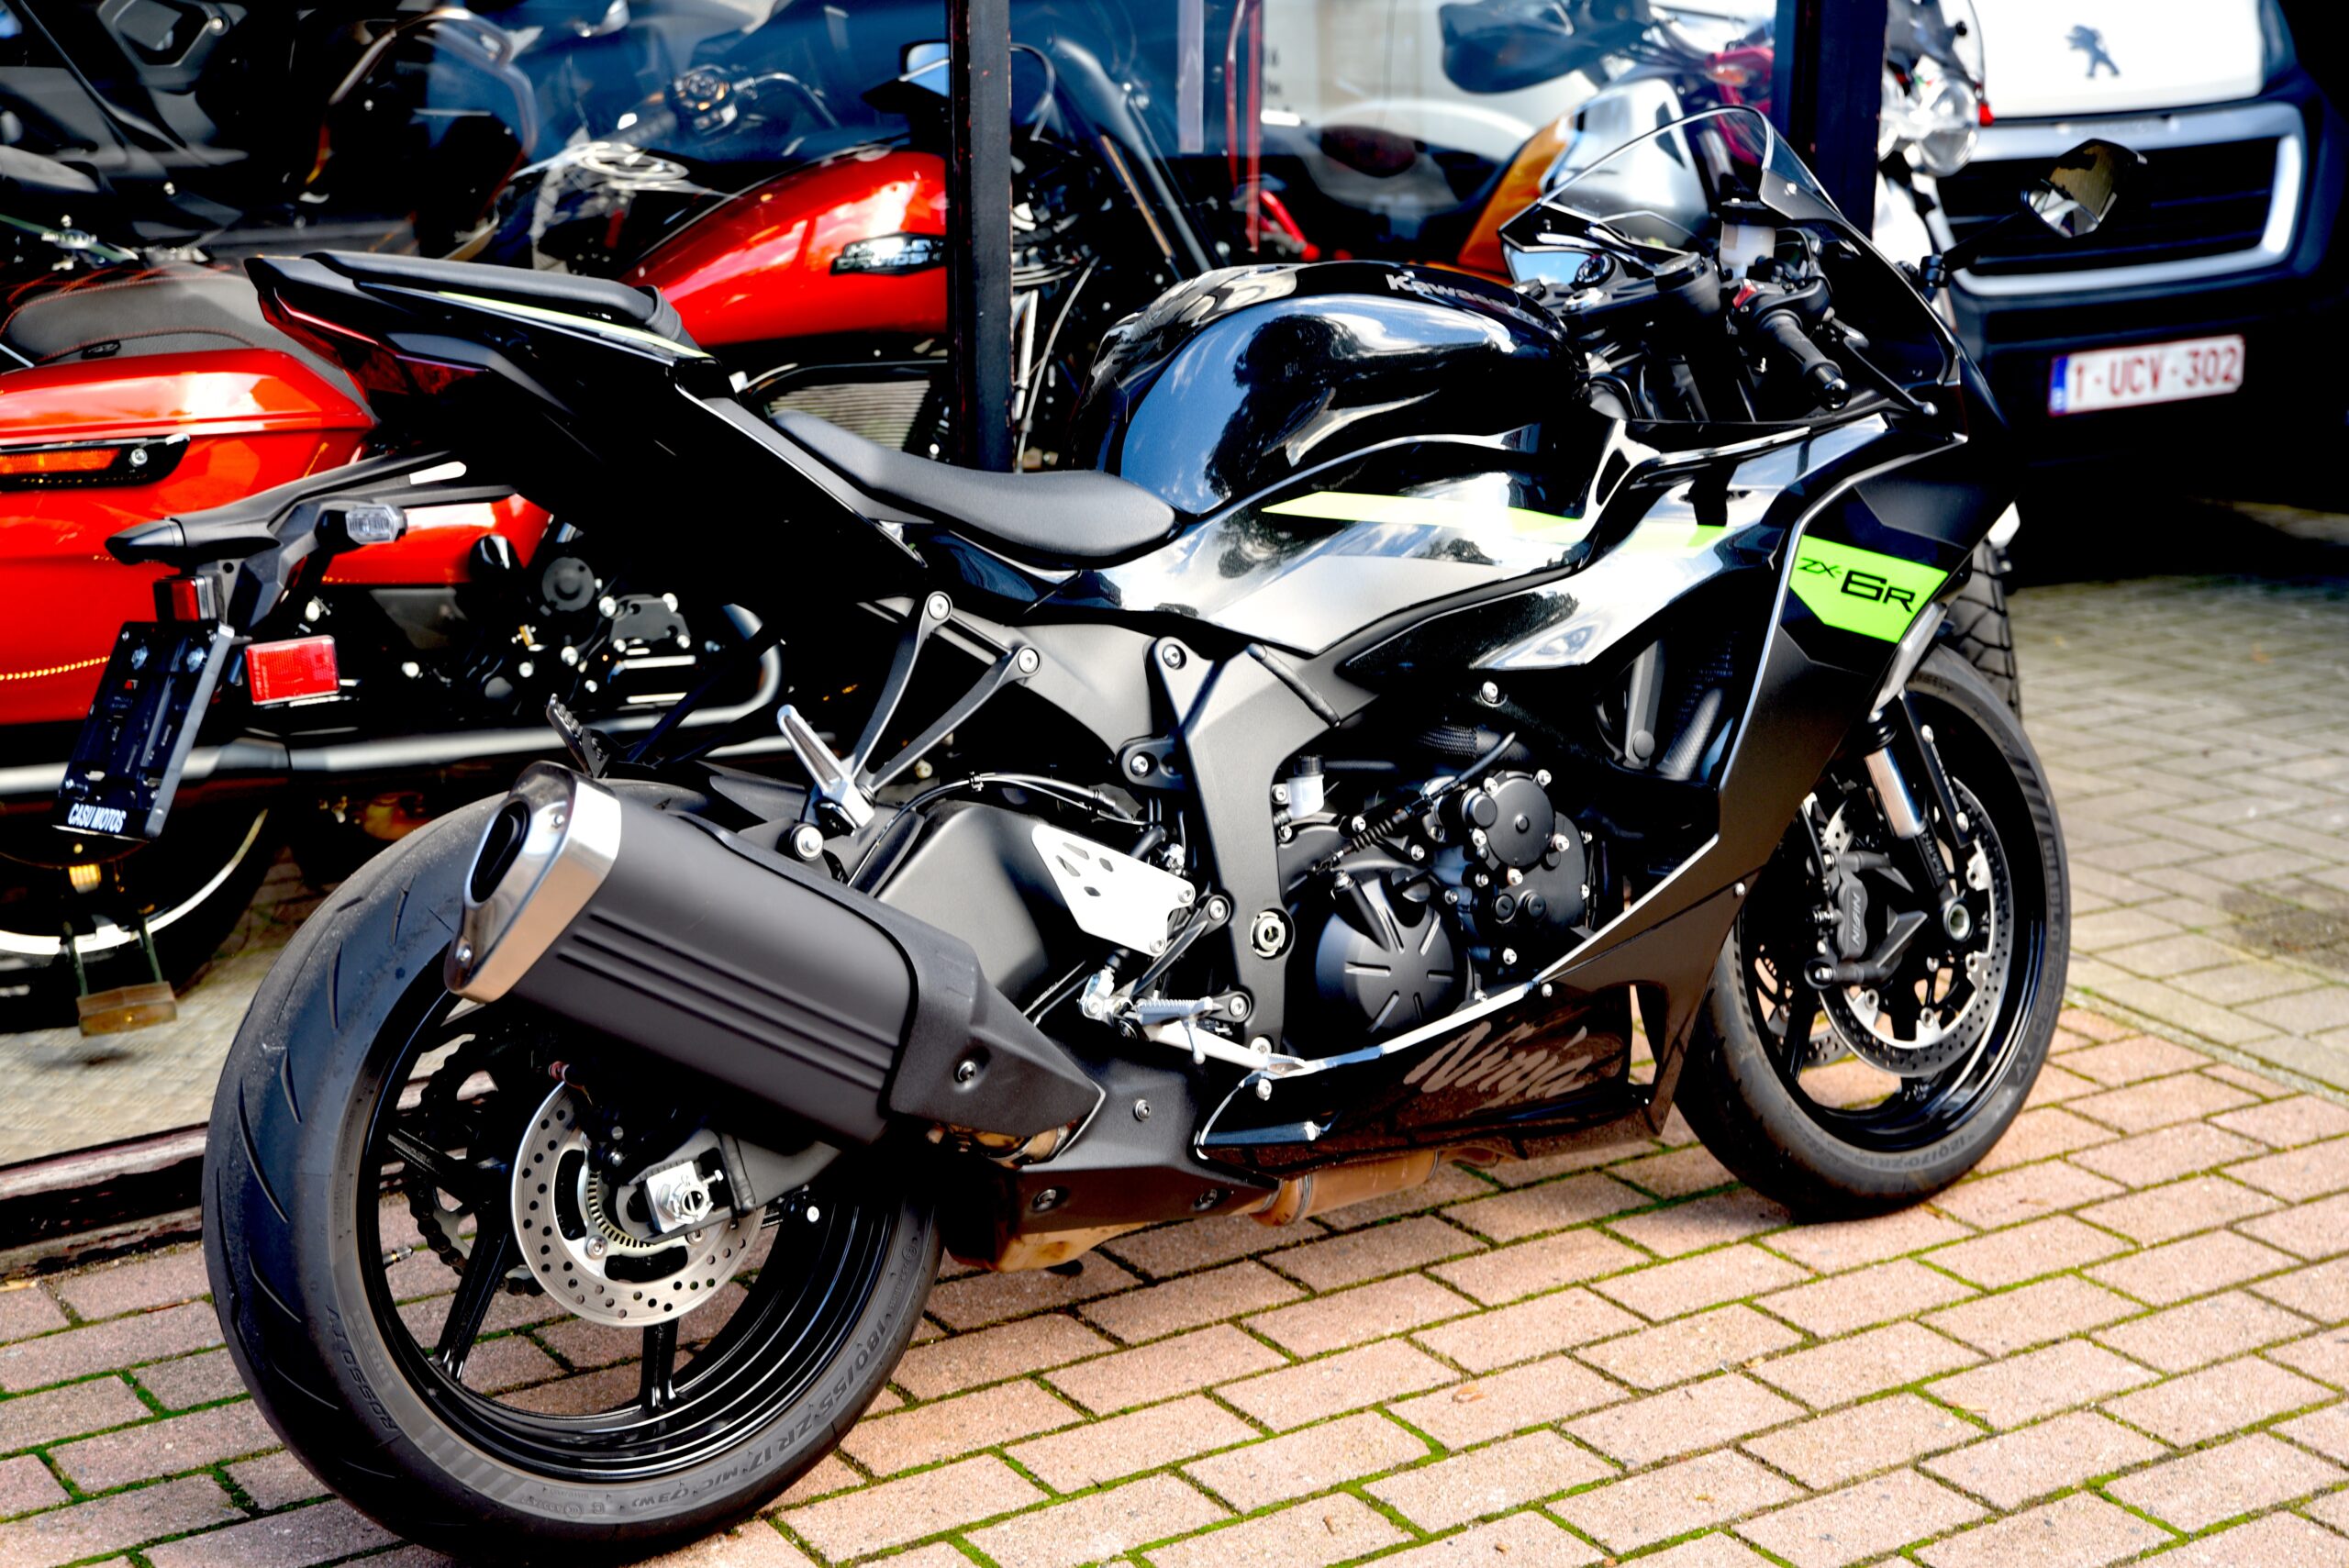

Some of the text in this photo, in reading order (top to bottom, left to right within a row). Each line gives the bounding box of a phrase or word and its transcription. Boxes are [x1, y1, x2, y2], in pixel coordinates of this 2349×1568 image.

[68, 803, 127, 833] CASU MOTOS
[2041, 836, 2062, 942] DIABLO
[2032, 951, 2062, 1036] ROSSO
[342, 1350, 398, 1432] ROSSO
[819, 1321, 886, 1410] 180/55
[698, 1467, 739, 1488] M/C
